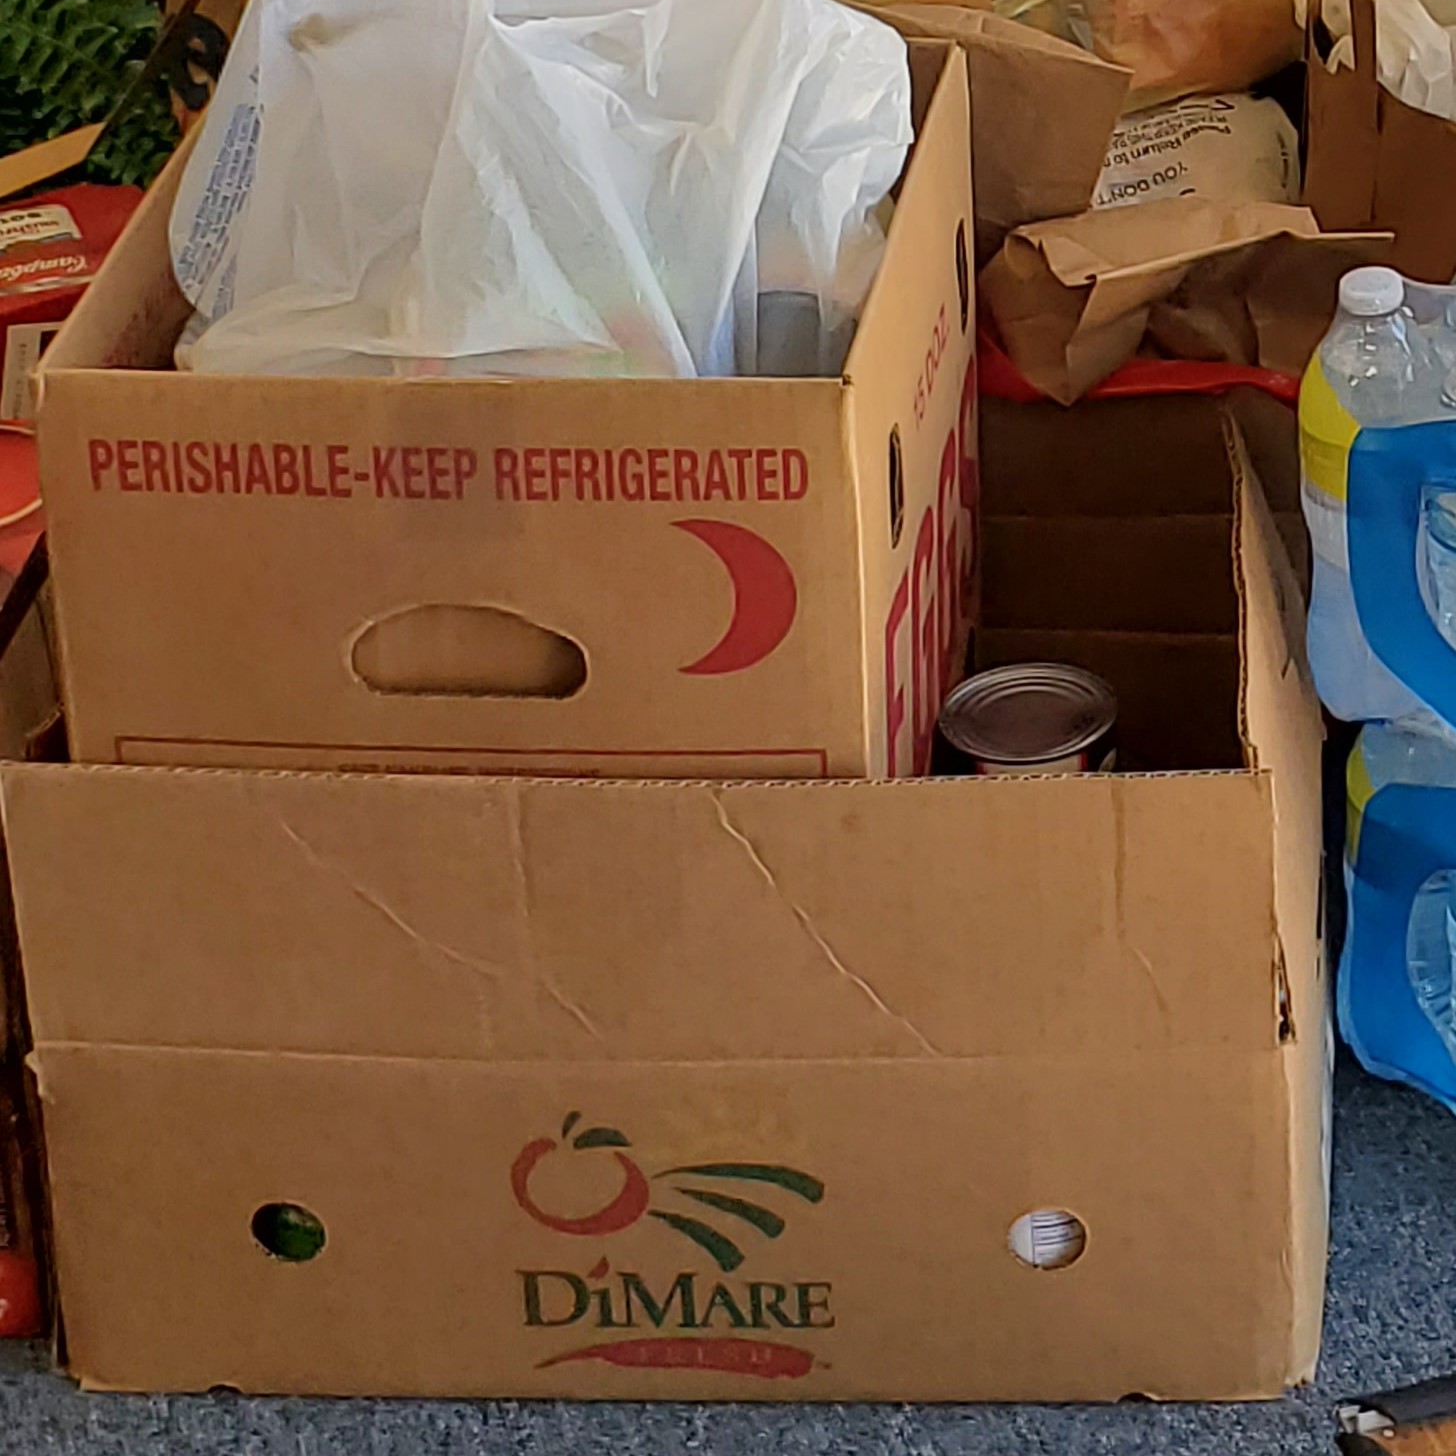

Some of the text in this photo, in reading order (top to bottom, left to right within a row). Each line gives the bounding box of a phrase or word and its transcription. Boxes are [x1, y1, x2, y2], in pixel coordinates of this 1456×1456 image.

[1113, 152, 1131, 168] to
[1130, 136, 1182, 162] Return
[1150, 161, 1190, 186] YOU
[89, 438, 808, 503] PERISHABLE-KEEP REFRIGERATED
[885, 354, 978, 778] EGGS
[514, 1255, 836, 1329] DiMARE
